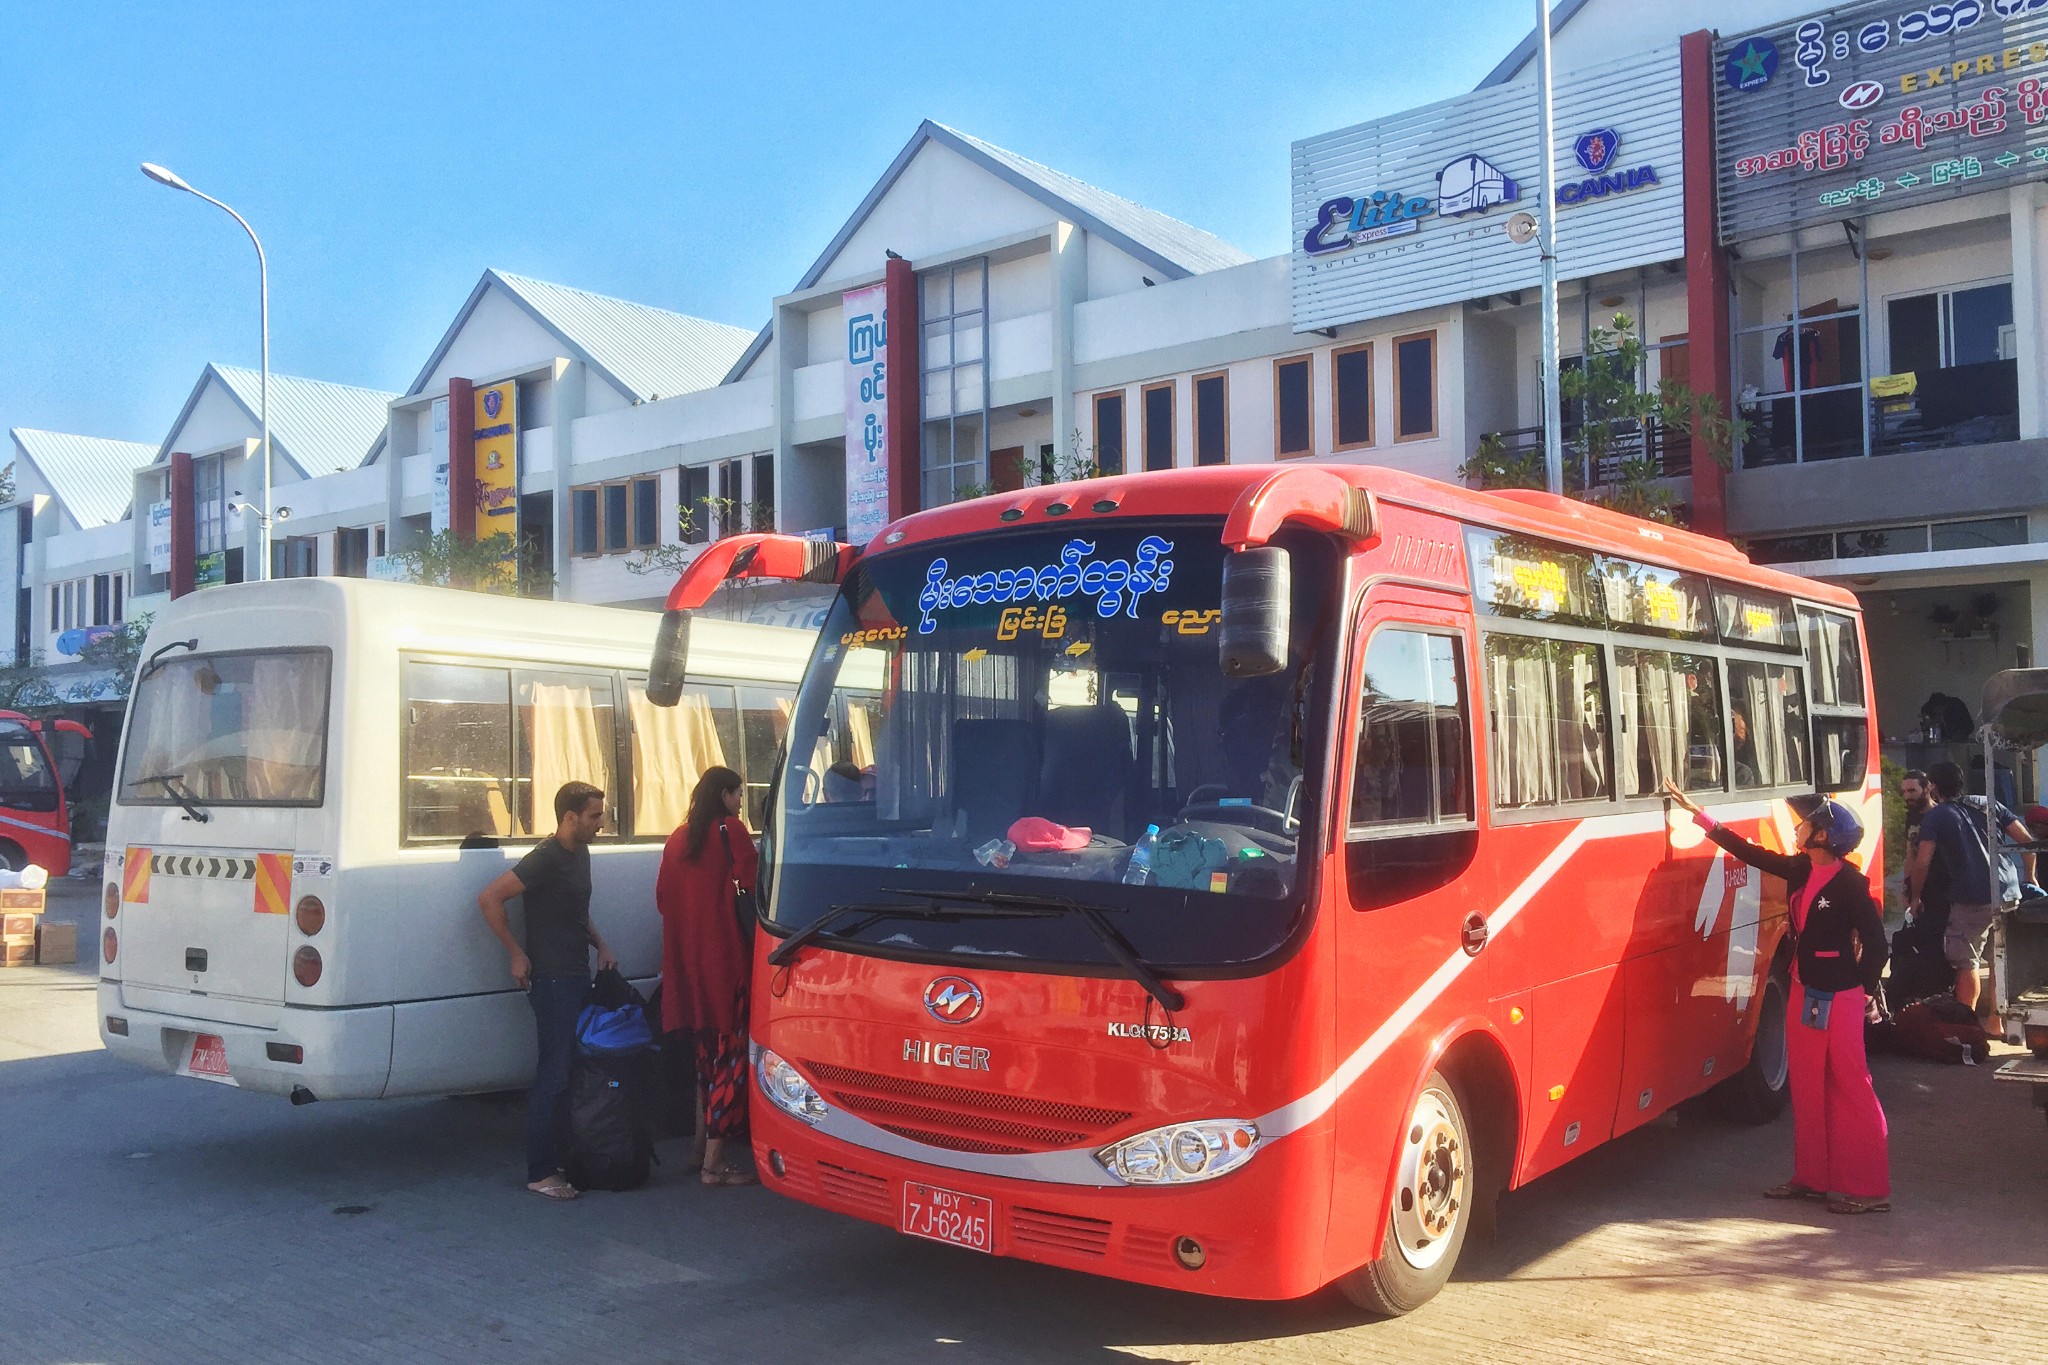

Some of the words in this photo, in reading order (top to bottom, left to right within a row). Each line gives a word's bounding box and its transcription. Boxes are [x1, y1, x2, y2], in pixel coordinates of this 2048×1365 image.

[1735, 118, 1873, 178] အဆင့်မြင့်
[1879, 86, 2009, 150] ခရီးသည်
[1931, 156, 1983, 186] မြင်းခြံ
[1303, 190, 1435, 258] Elite
[1357, 228, 1388, 243] Express
[1310, 242, 1425, 273] BUILDING
[1452, 223, 1510, 241] TRUS
[918, 535, 1175, 635] မိုးသောက်ထွန်း
[996, 605, 1068, 641] မြင်းခြံ
[903, 1038, 990, 1071] HIGER
[933, 1191, 961, 1210] MDY
[909, 1202, 985, 1246] 7J-6245
